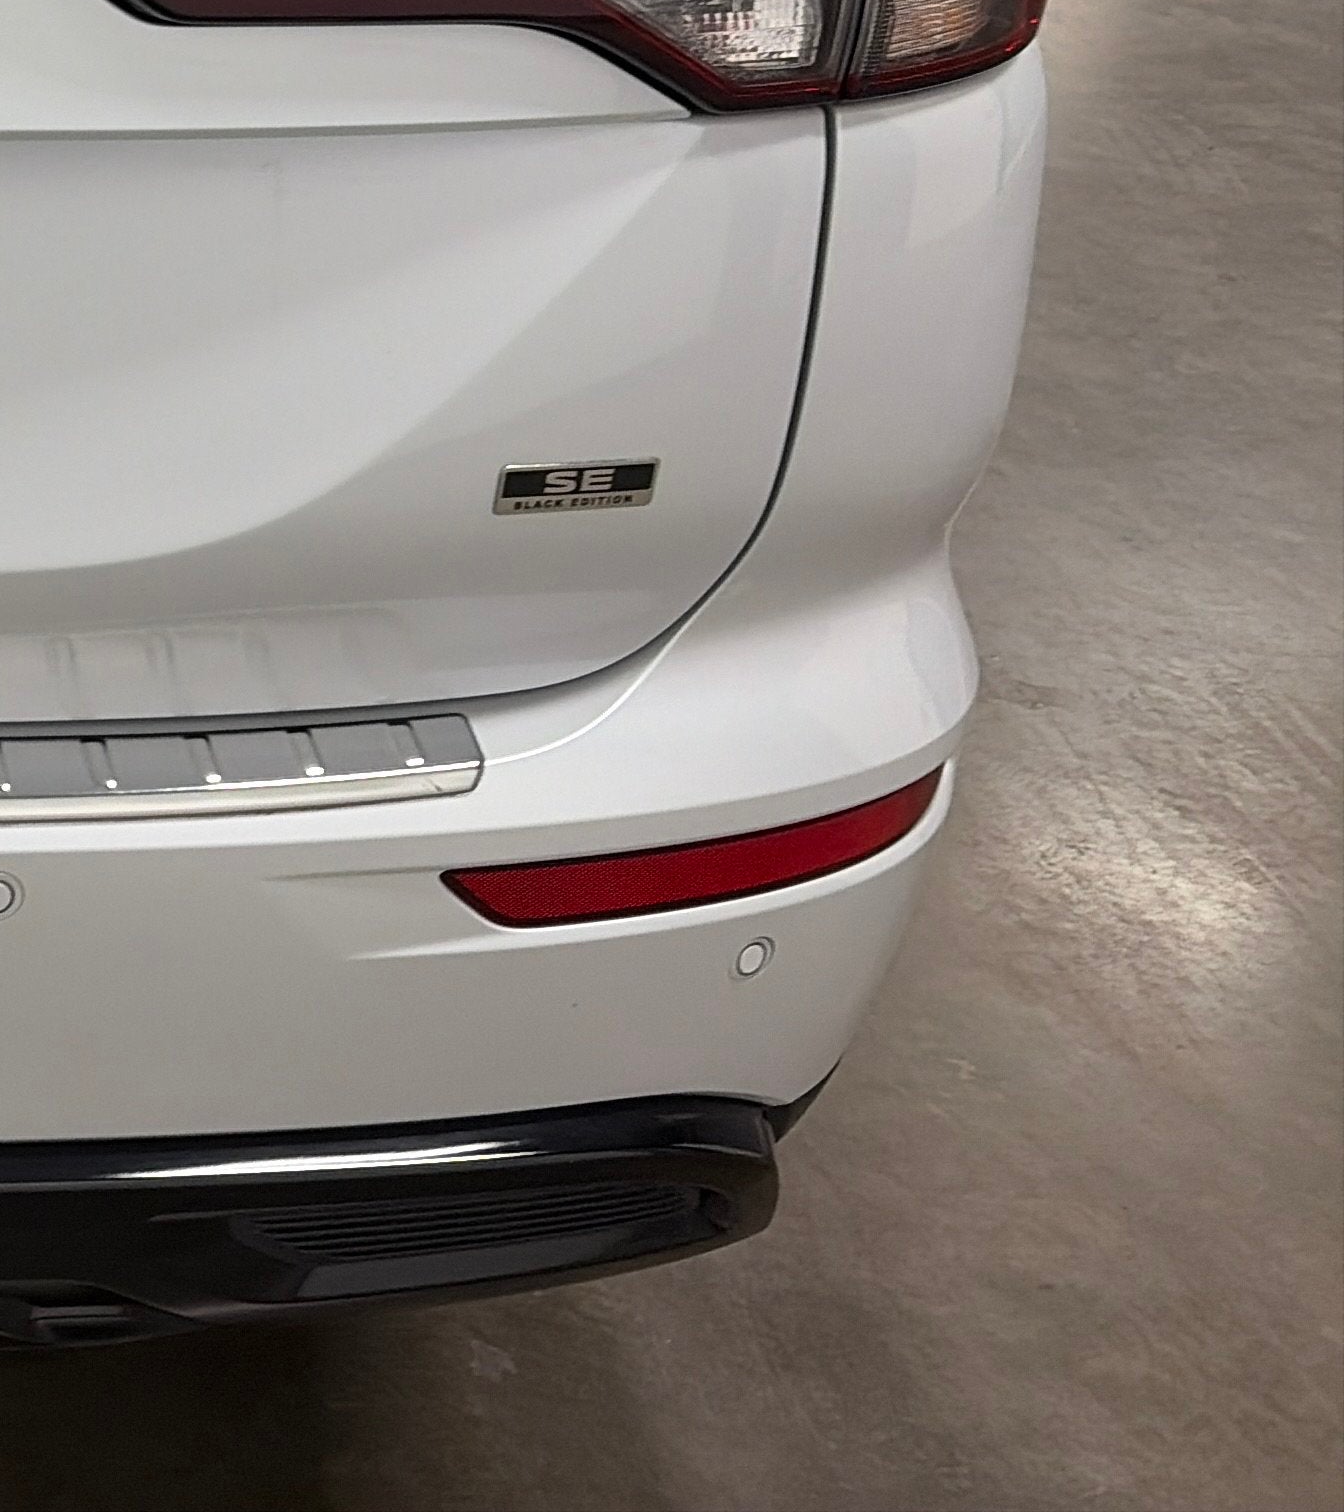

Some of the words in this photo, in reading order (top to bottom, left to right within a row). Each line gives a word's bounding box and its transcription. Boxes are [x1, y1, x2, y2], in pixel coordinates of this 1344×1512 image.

[543, 468, 616, 494] SE
[514, 498, 565, 511] BLACK
[570, 494, 633, 508] EDITION
